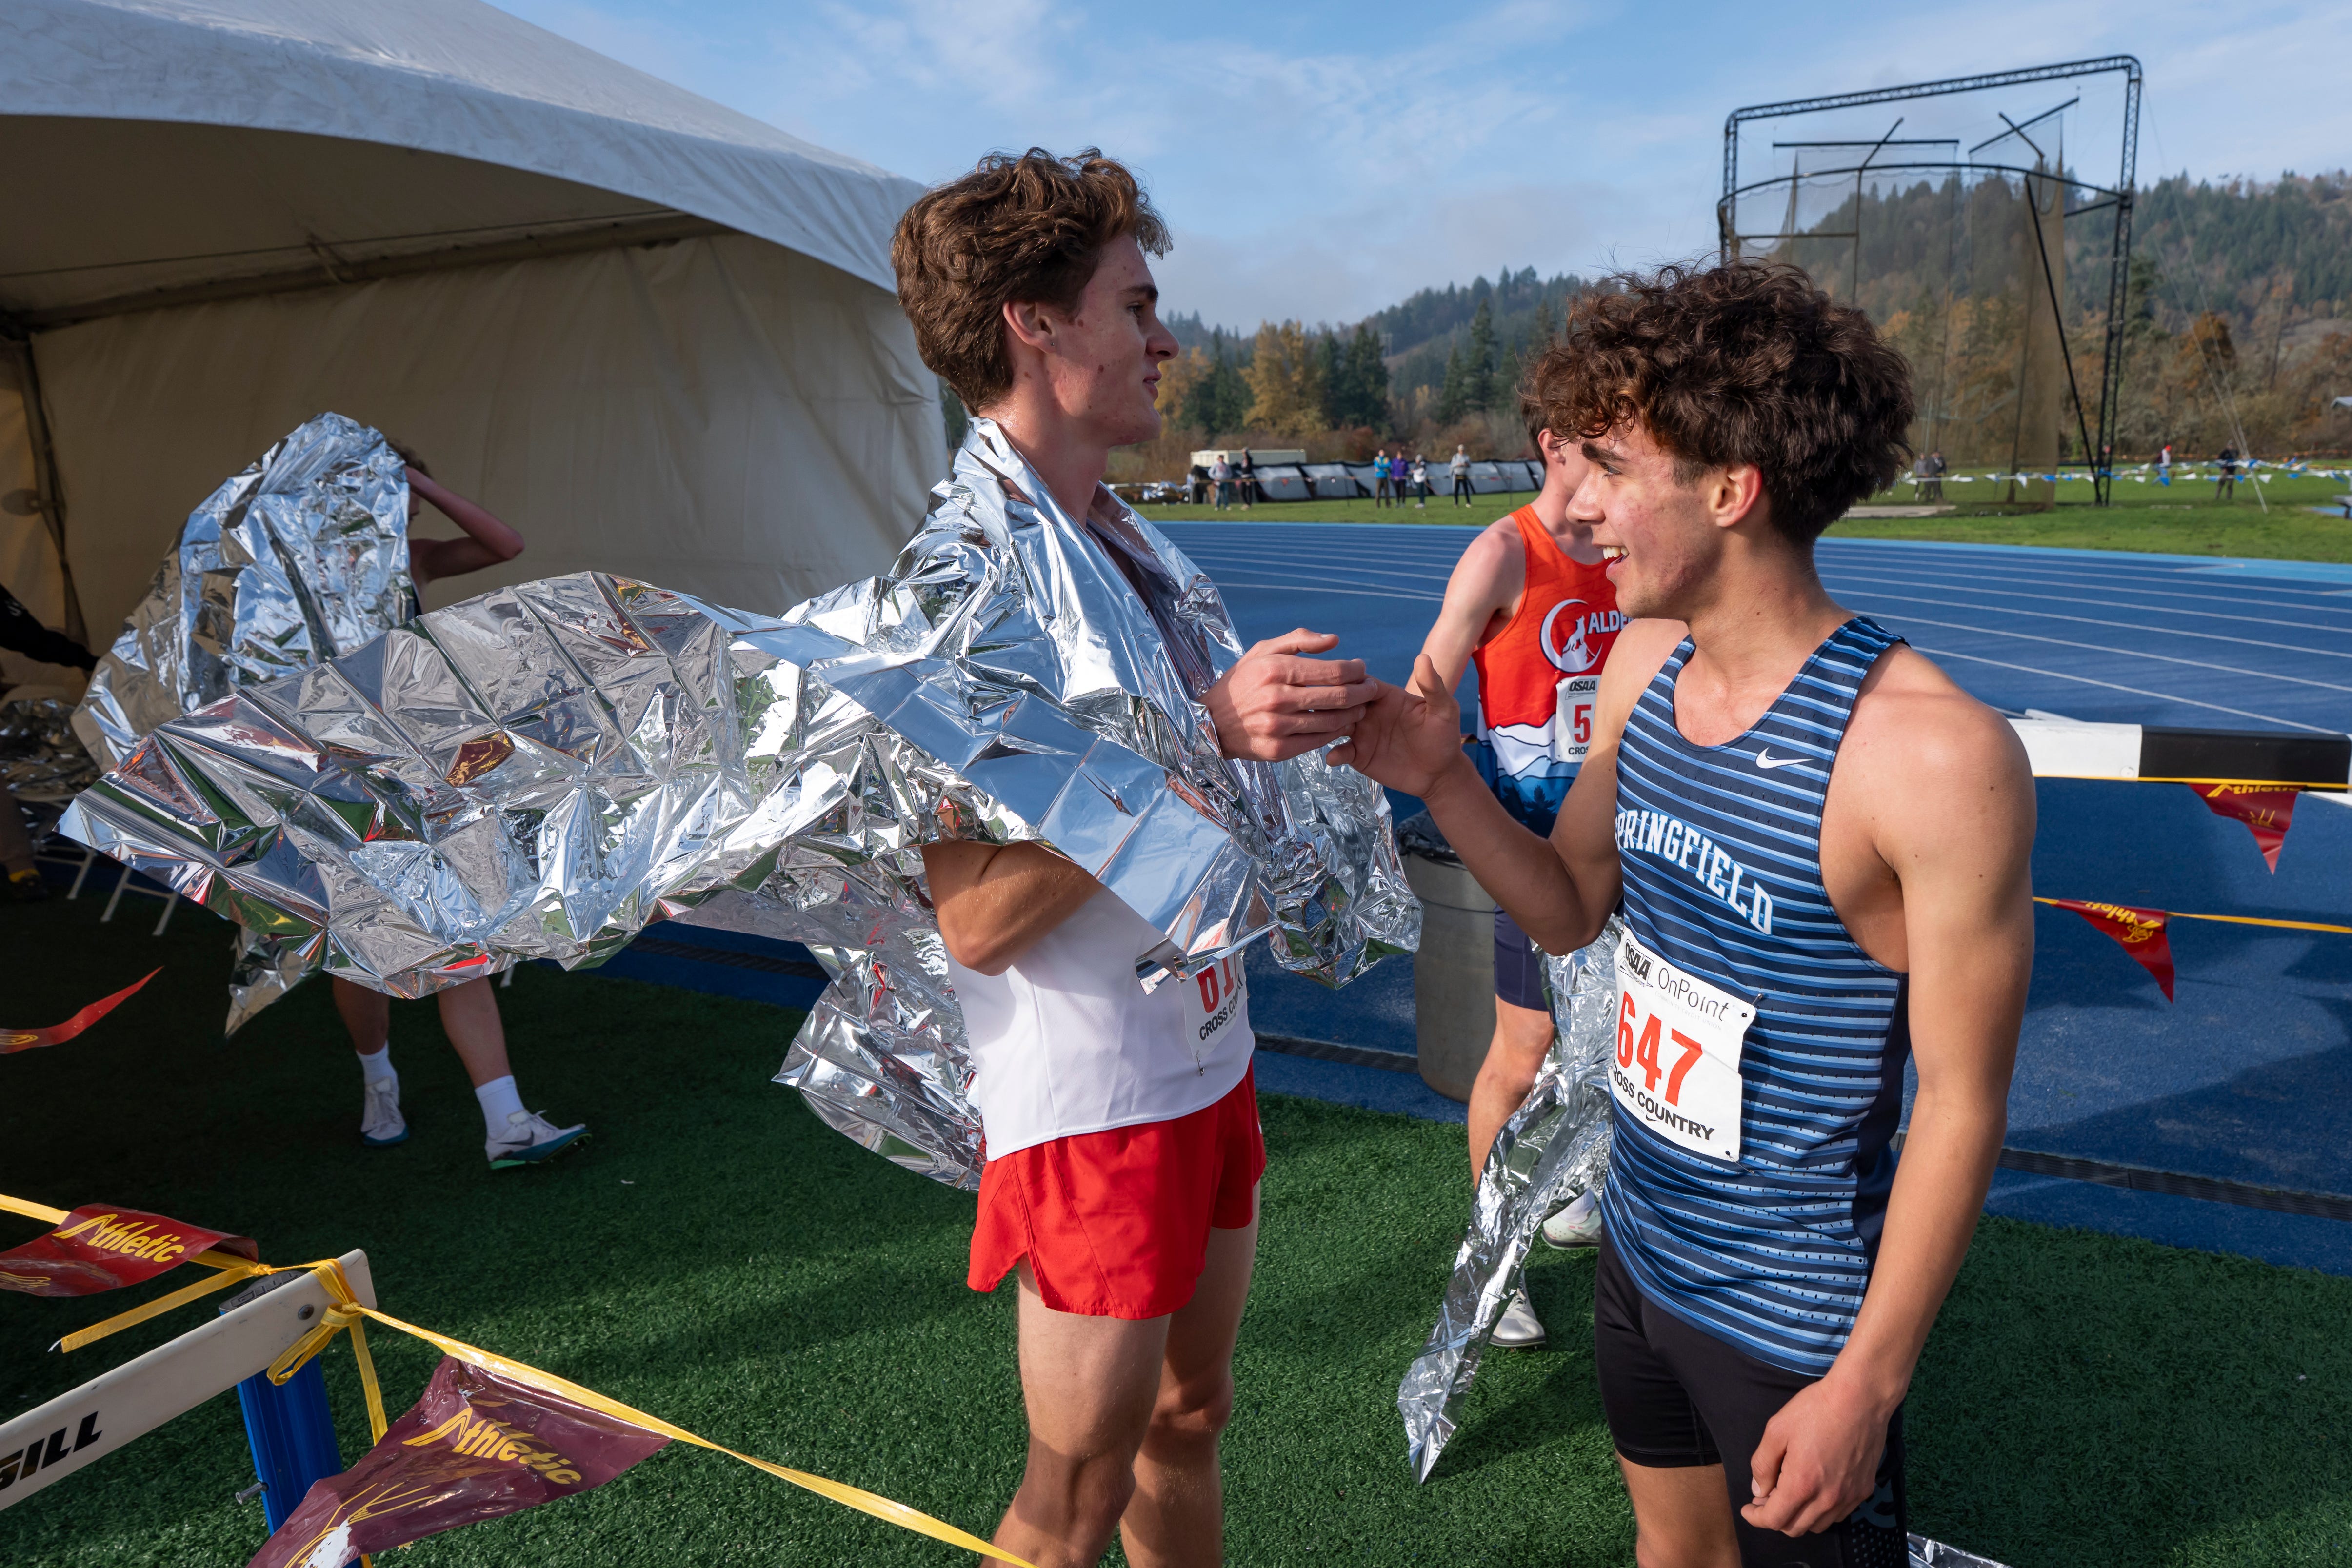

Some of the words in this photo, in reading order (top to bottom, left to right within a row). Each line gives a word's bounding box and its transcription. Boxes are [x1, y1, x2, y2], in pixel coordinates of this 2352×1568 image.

[1569, 680, 1596, 692] OSAA
[1574, 704, 1592, 744] 5
[1625, 941, 1652, 981] OSAA
[1658, 967, 1729, 1021] OnPoint
[1199, 1006, 1228, 1041] CROSS
[1617, 991, 1703, 1107] 647
[1637, 1091, 1715, 1141] COUNTRY
[52, 1214, 185, 1262] Athletic
[401, 1407, 581, 1484] Athletic
